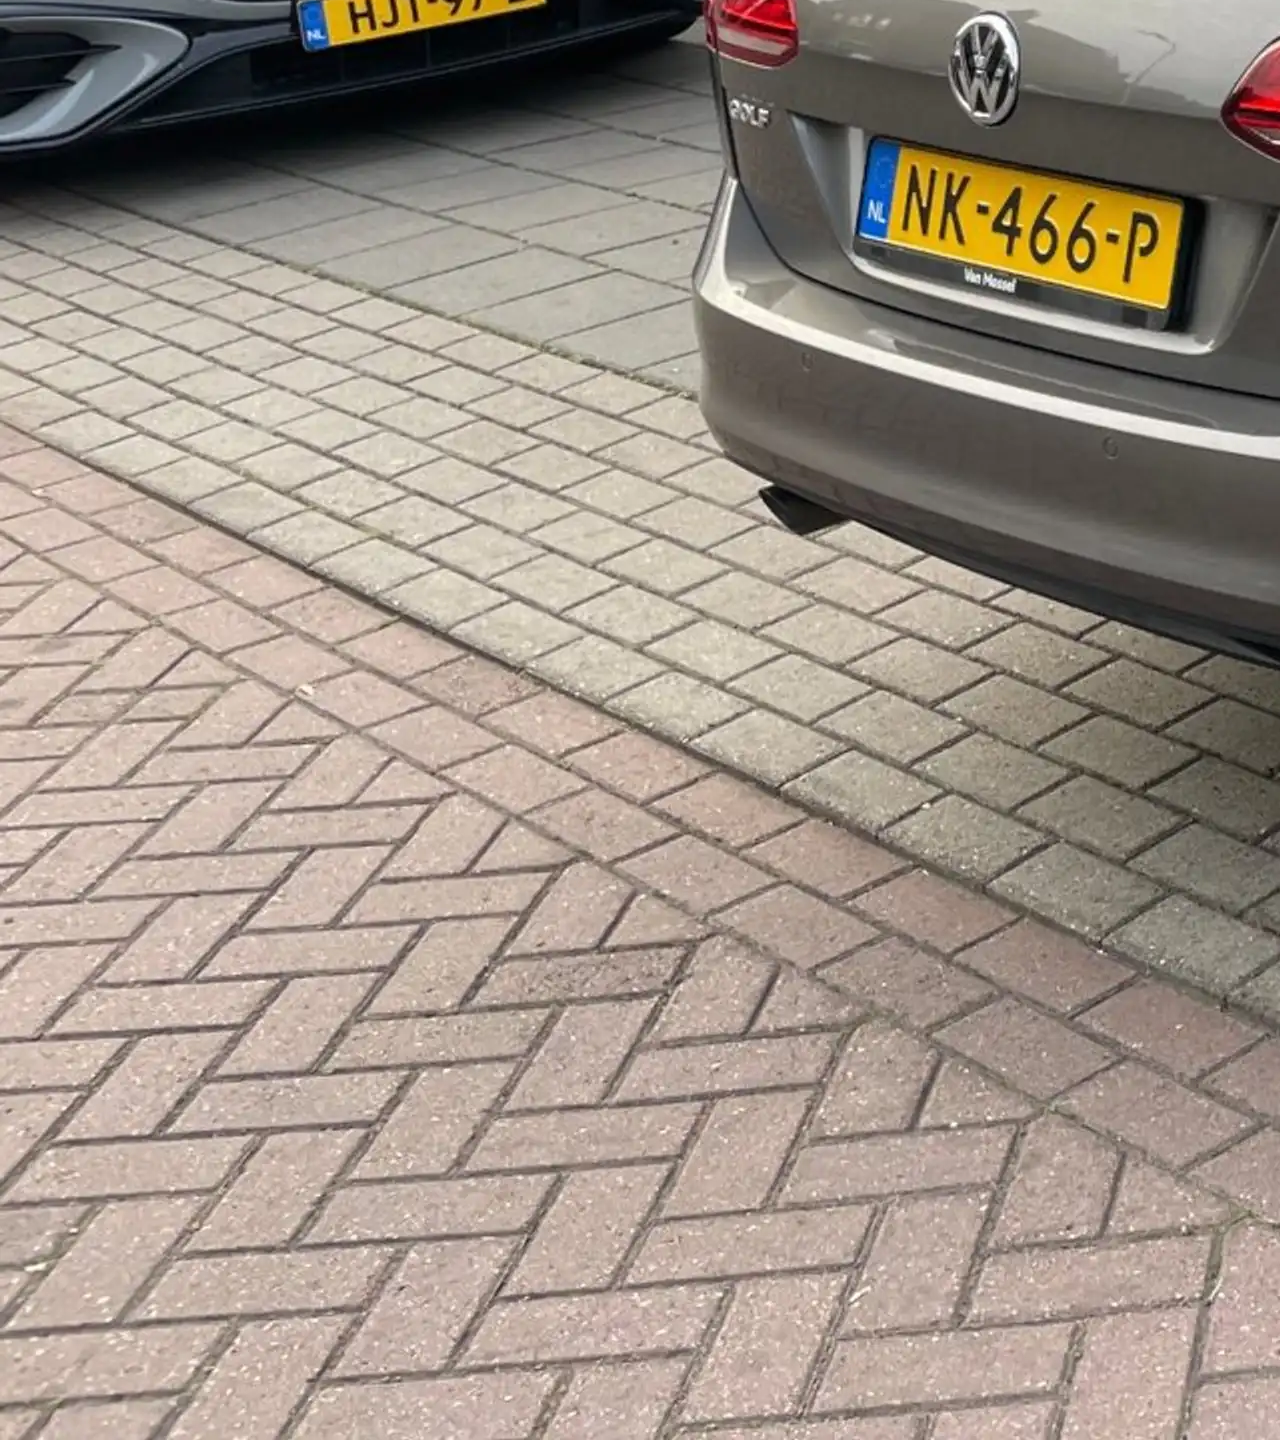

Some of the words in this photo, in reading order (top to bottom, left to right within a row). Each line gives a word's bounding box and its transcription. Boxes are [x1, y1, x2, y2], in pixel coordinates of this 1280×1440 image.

[307, 29, 327, 41] NL
[867, 199, 886, 224] NL
[902, 163, 1161, 285] NK-466-P
[964, 265, 982, 286] Van
